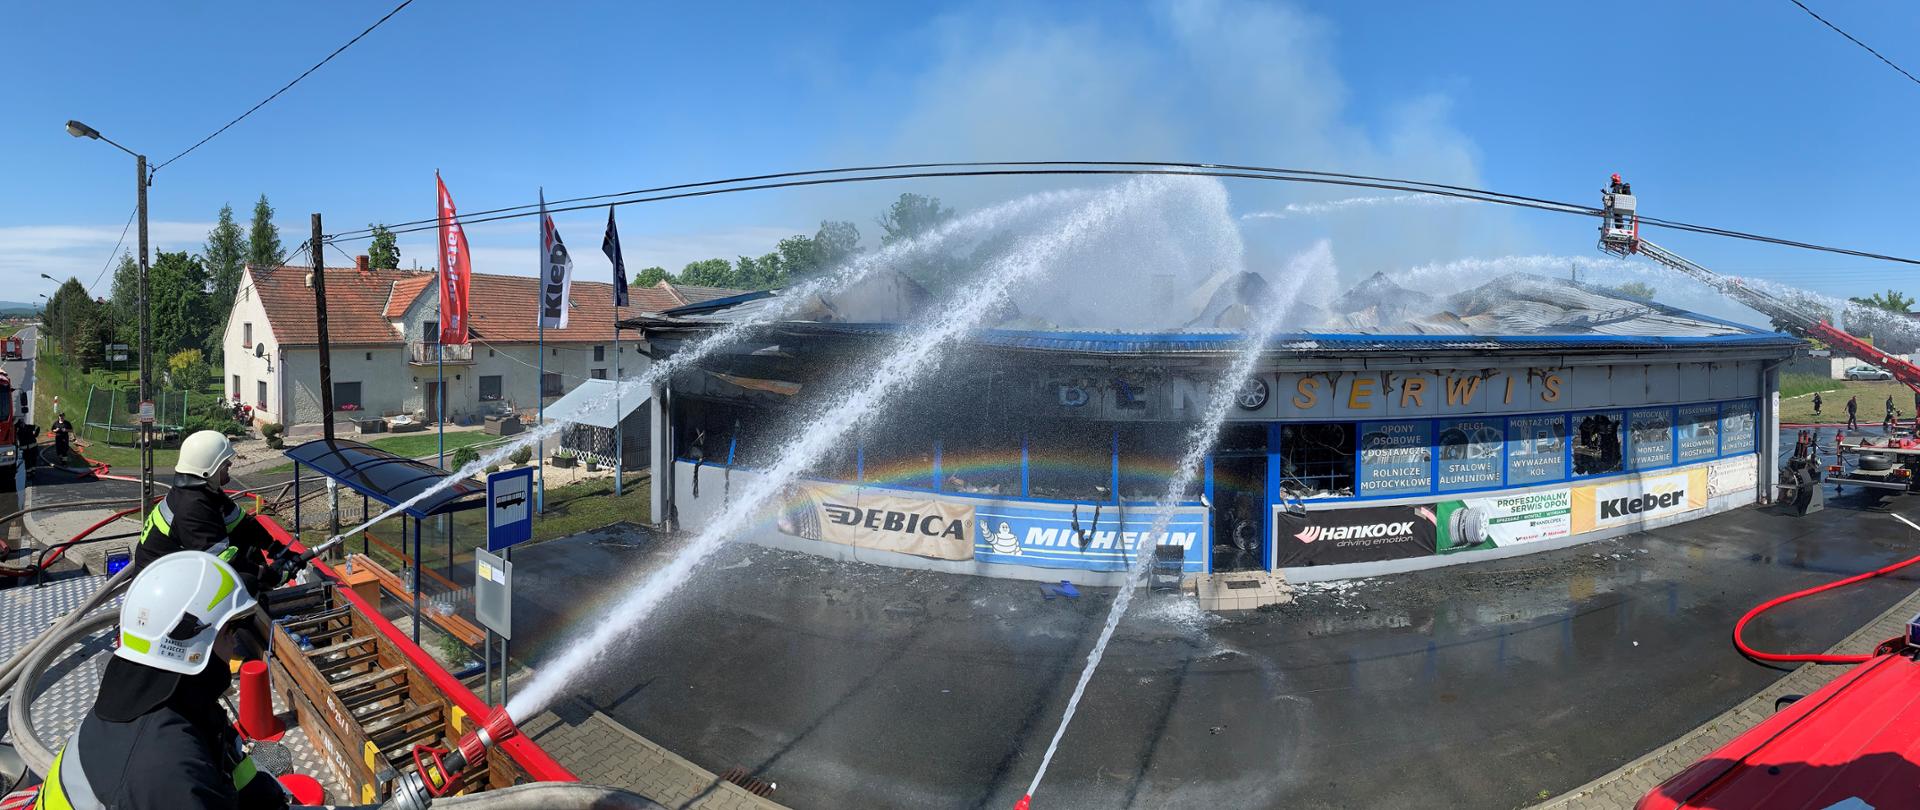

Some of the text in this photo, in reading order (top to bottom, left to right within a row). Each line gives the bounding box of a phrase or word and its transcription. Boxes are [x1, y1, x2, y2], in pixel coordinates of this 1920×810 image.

[1293, 375, 1564, 409] SERWIS
[1633, 409, 1669, 418] MOTOCYKLE
[1381, 424, 1414, 434] OPONY
[1373, 435, 1421, 445] OSOBOWE
[1368, 447, 1425, 457] DOSTAWCZE
[1373, 467, 1421, 477] ROLNICZE
[1449, 462, 1491, 473] STALOWE
[1361, 477, 1431, 490] MOTOCYKLOWE
[1440, 473, 1500, 484] ALUMINIOWE
[1497, 491, 1567, 508] PROFESJONALNY
[1601, 489, 1684, 520] Kleber
[1511, 499, 1567, 513] SERWIS OPON
[1336, 535, 1413, 548] driving emotion
